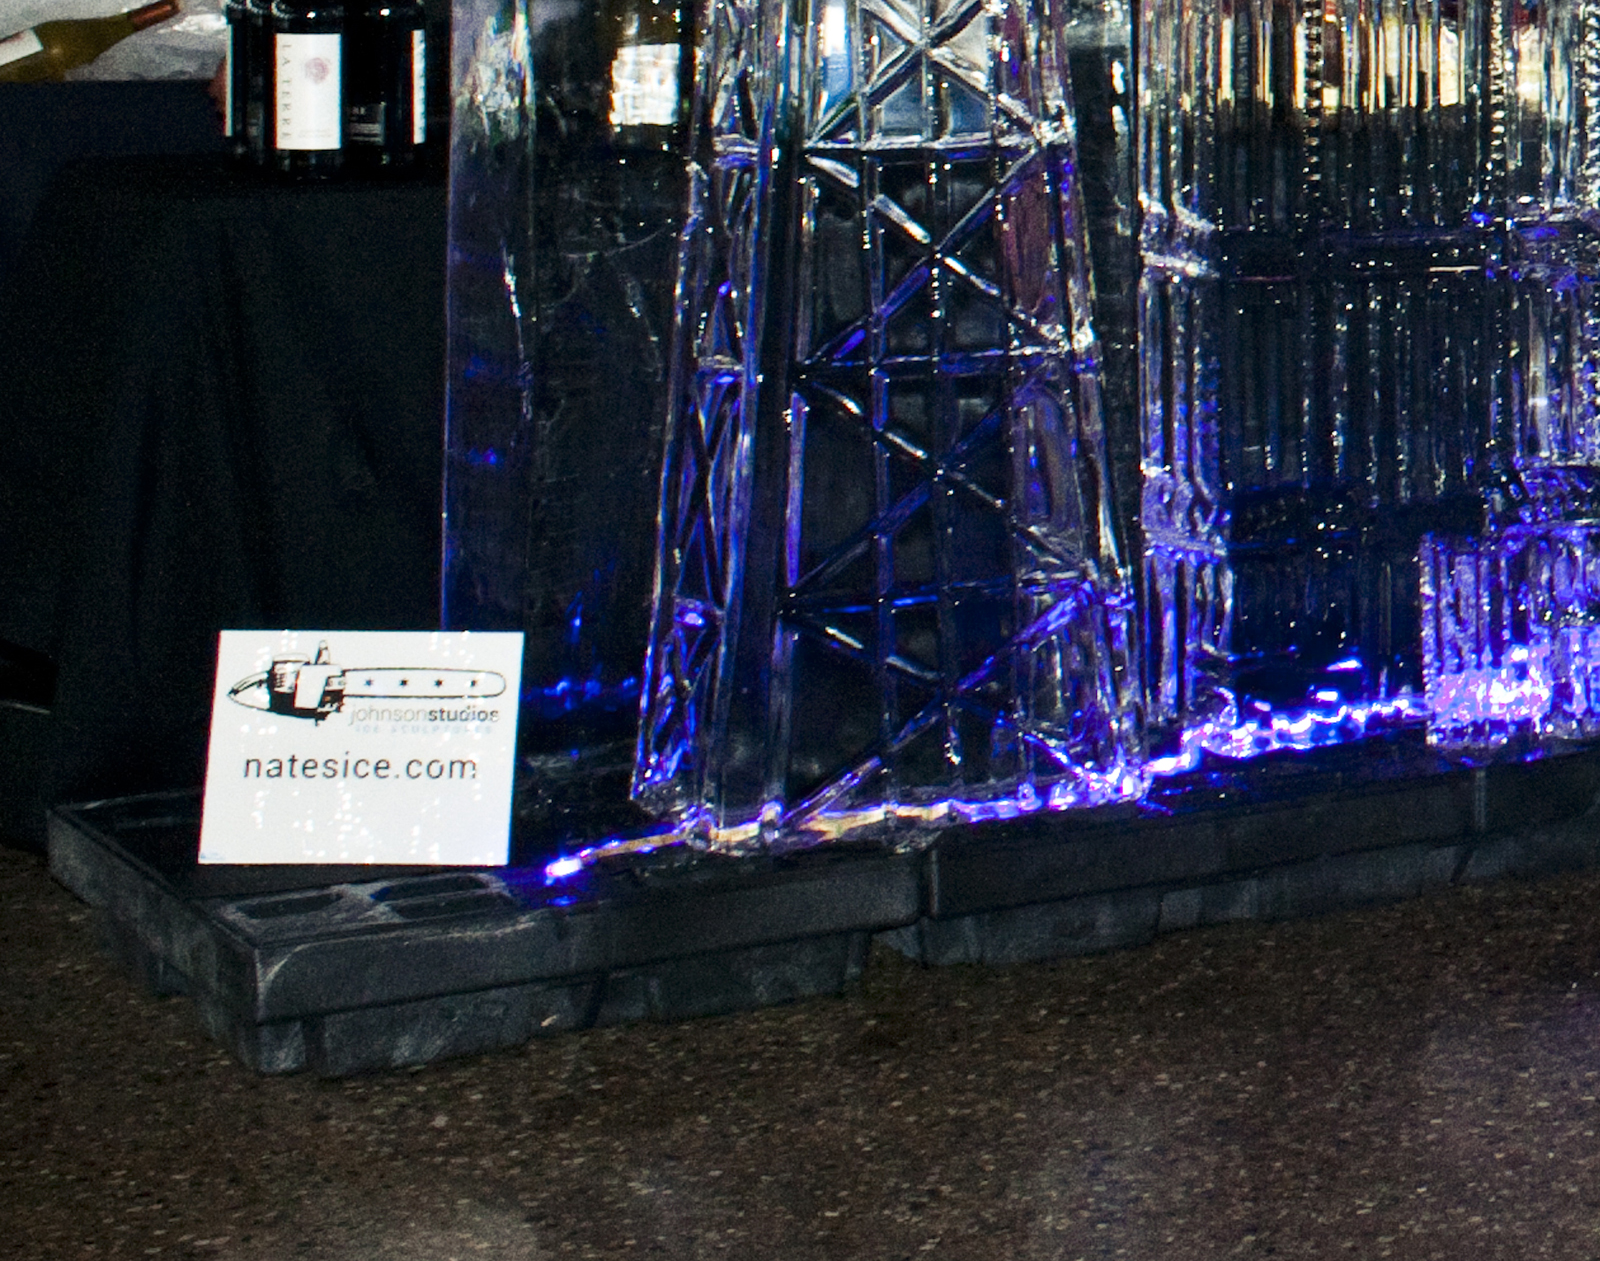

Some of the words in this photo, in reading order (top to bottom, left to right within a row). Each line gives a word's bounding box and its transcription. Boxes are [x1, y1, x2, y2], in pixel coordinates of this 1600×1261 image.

[281, 43, 293, 67] LA
[348, 705, 500, 726] johnsonstudios
[243, 752, 477, 779] natesice.com
